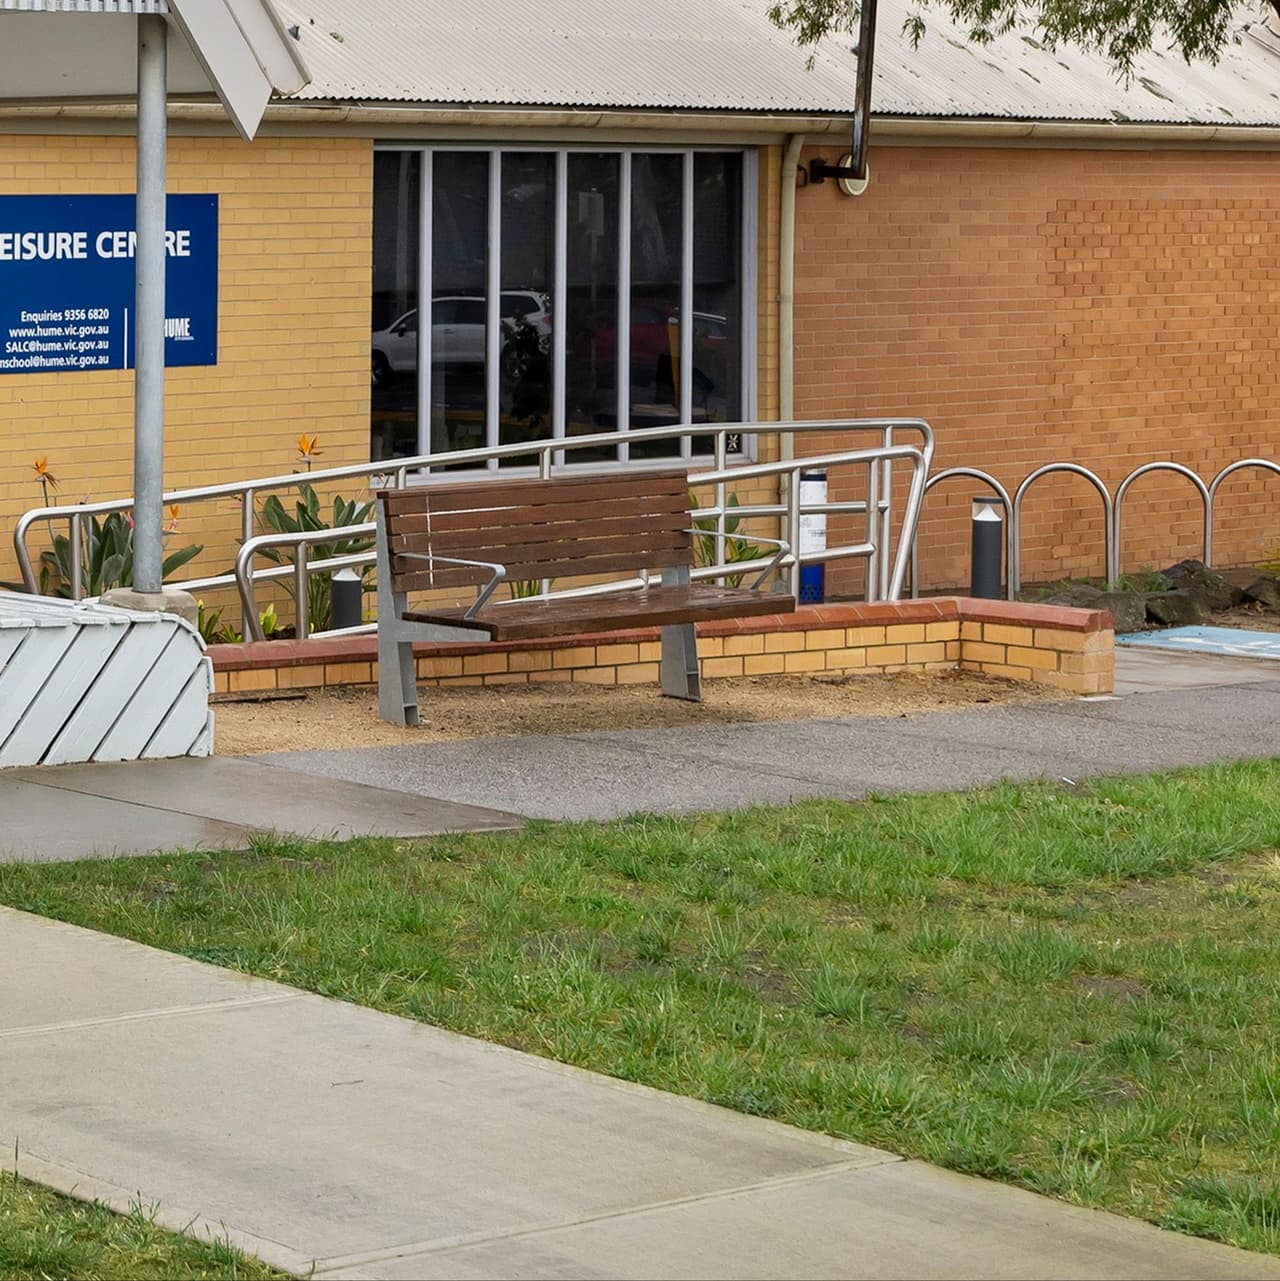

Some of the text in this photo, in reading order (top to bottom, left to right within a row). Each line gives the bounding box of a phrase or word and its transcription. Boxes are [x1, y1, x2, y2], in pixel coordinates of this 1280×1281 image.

[96, 230, 190, 259] CENRE
[21, 308, 109, 324] Enquiries 9356 6820
[9, 324, 109, 338] www.hume.vic.gov.au
[6, 340, 109, 353] SALC@hume.vic.gov.au
